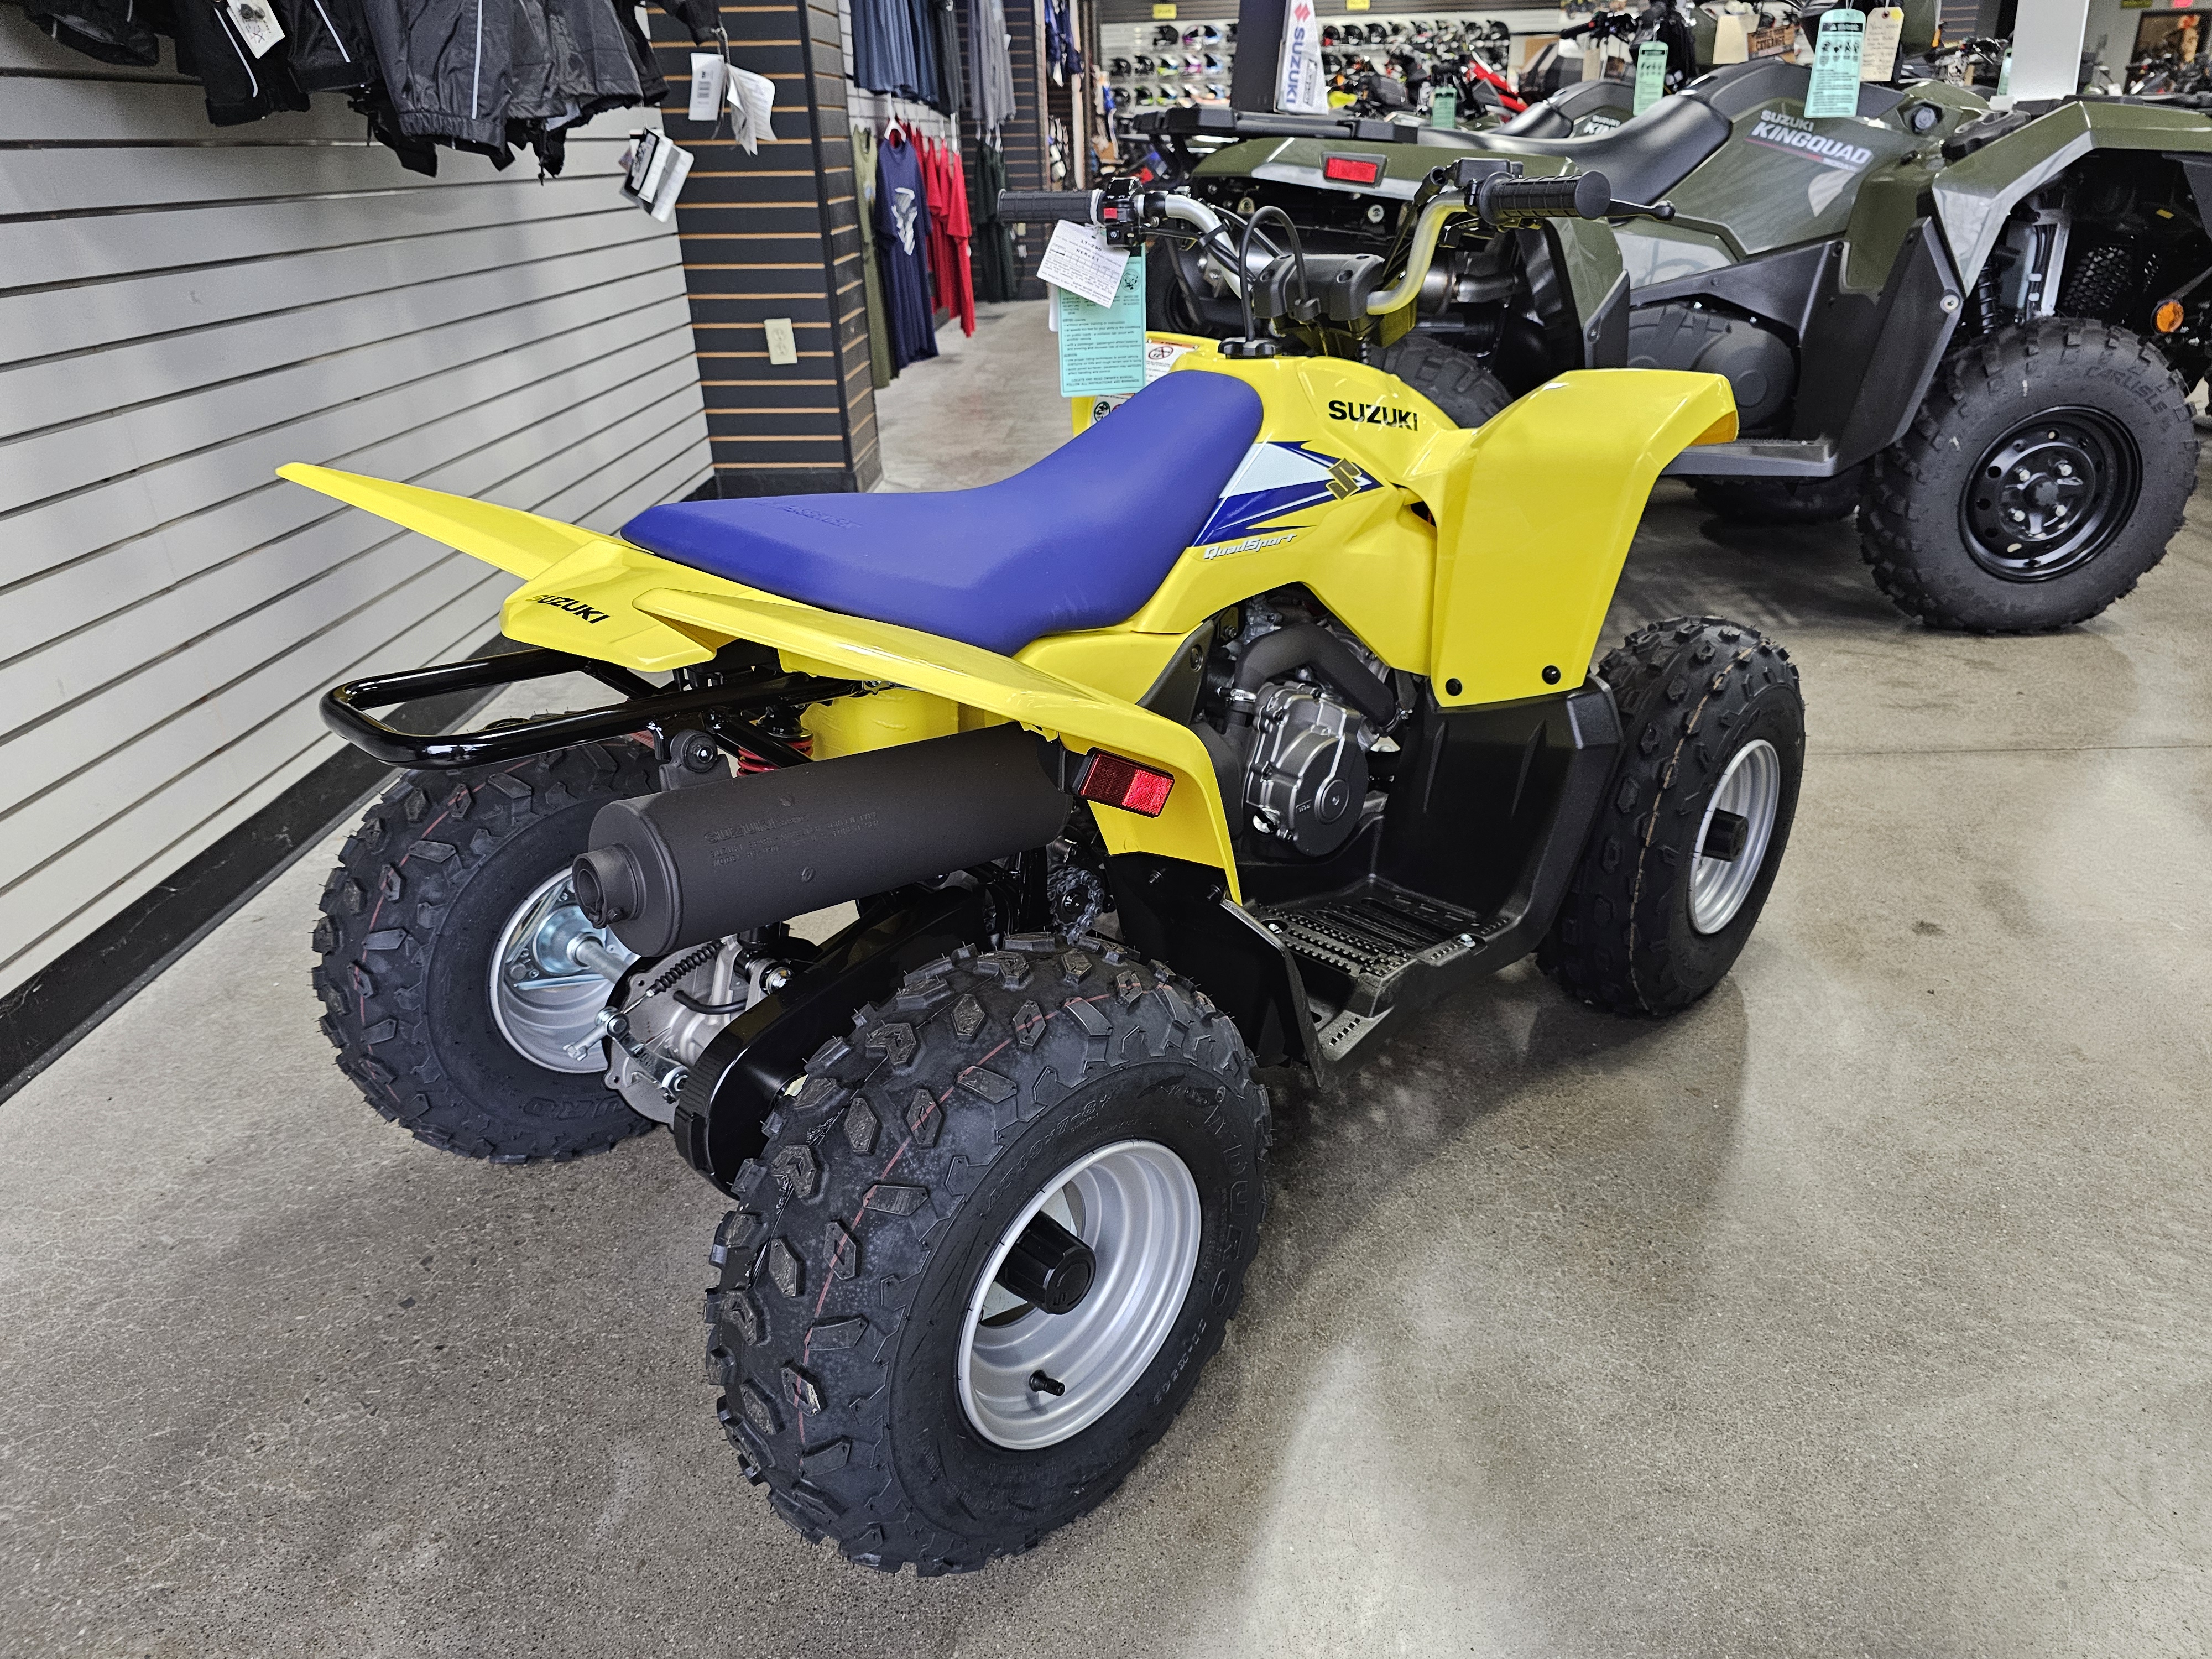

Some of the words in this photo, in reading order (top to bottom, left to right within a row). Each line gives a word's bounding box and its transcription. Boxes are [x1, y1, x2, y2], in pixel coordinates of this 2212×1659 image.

[1286, 27, 1305, 104] SUZUKI
[1760, 109, 1814, 133] SUZUKI
[1751, 121, 1874, 165] KINGQUAD
[1328, 400, 1418, 431] SUZUKI
[1203, 533, 1298, 560] QuadSport
[525, 594, 611, 624] SUZUKI
[703, 816, 776, 845] SUZUKI
[1211, 1144, 1249, 1307] DURO
